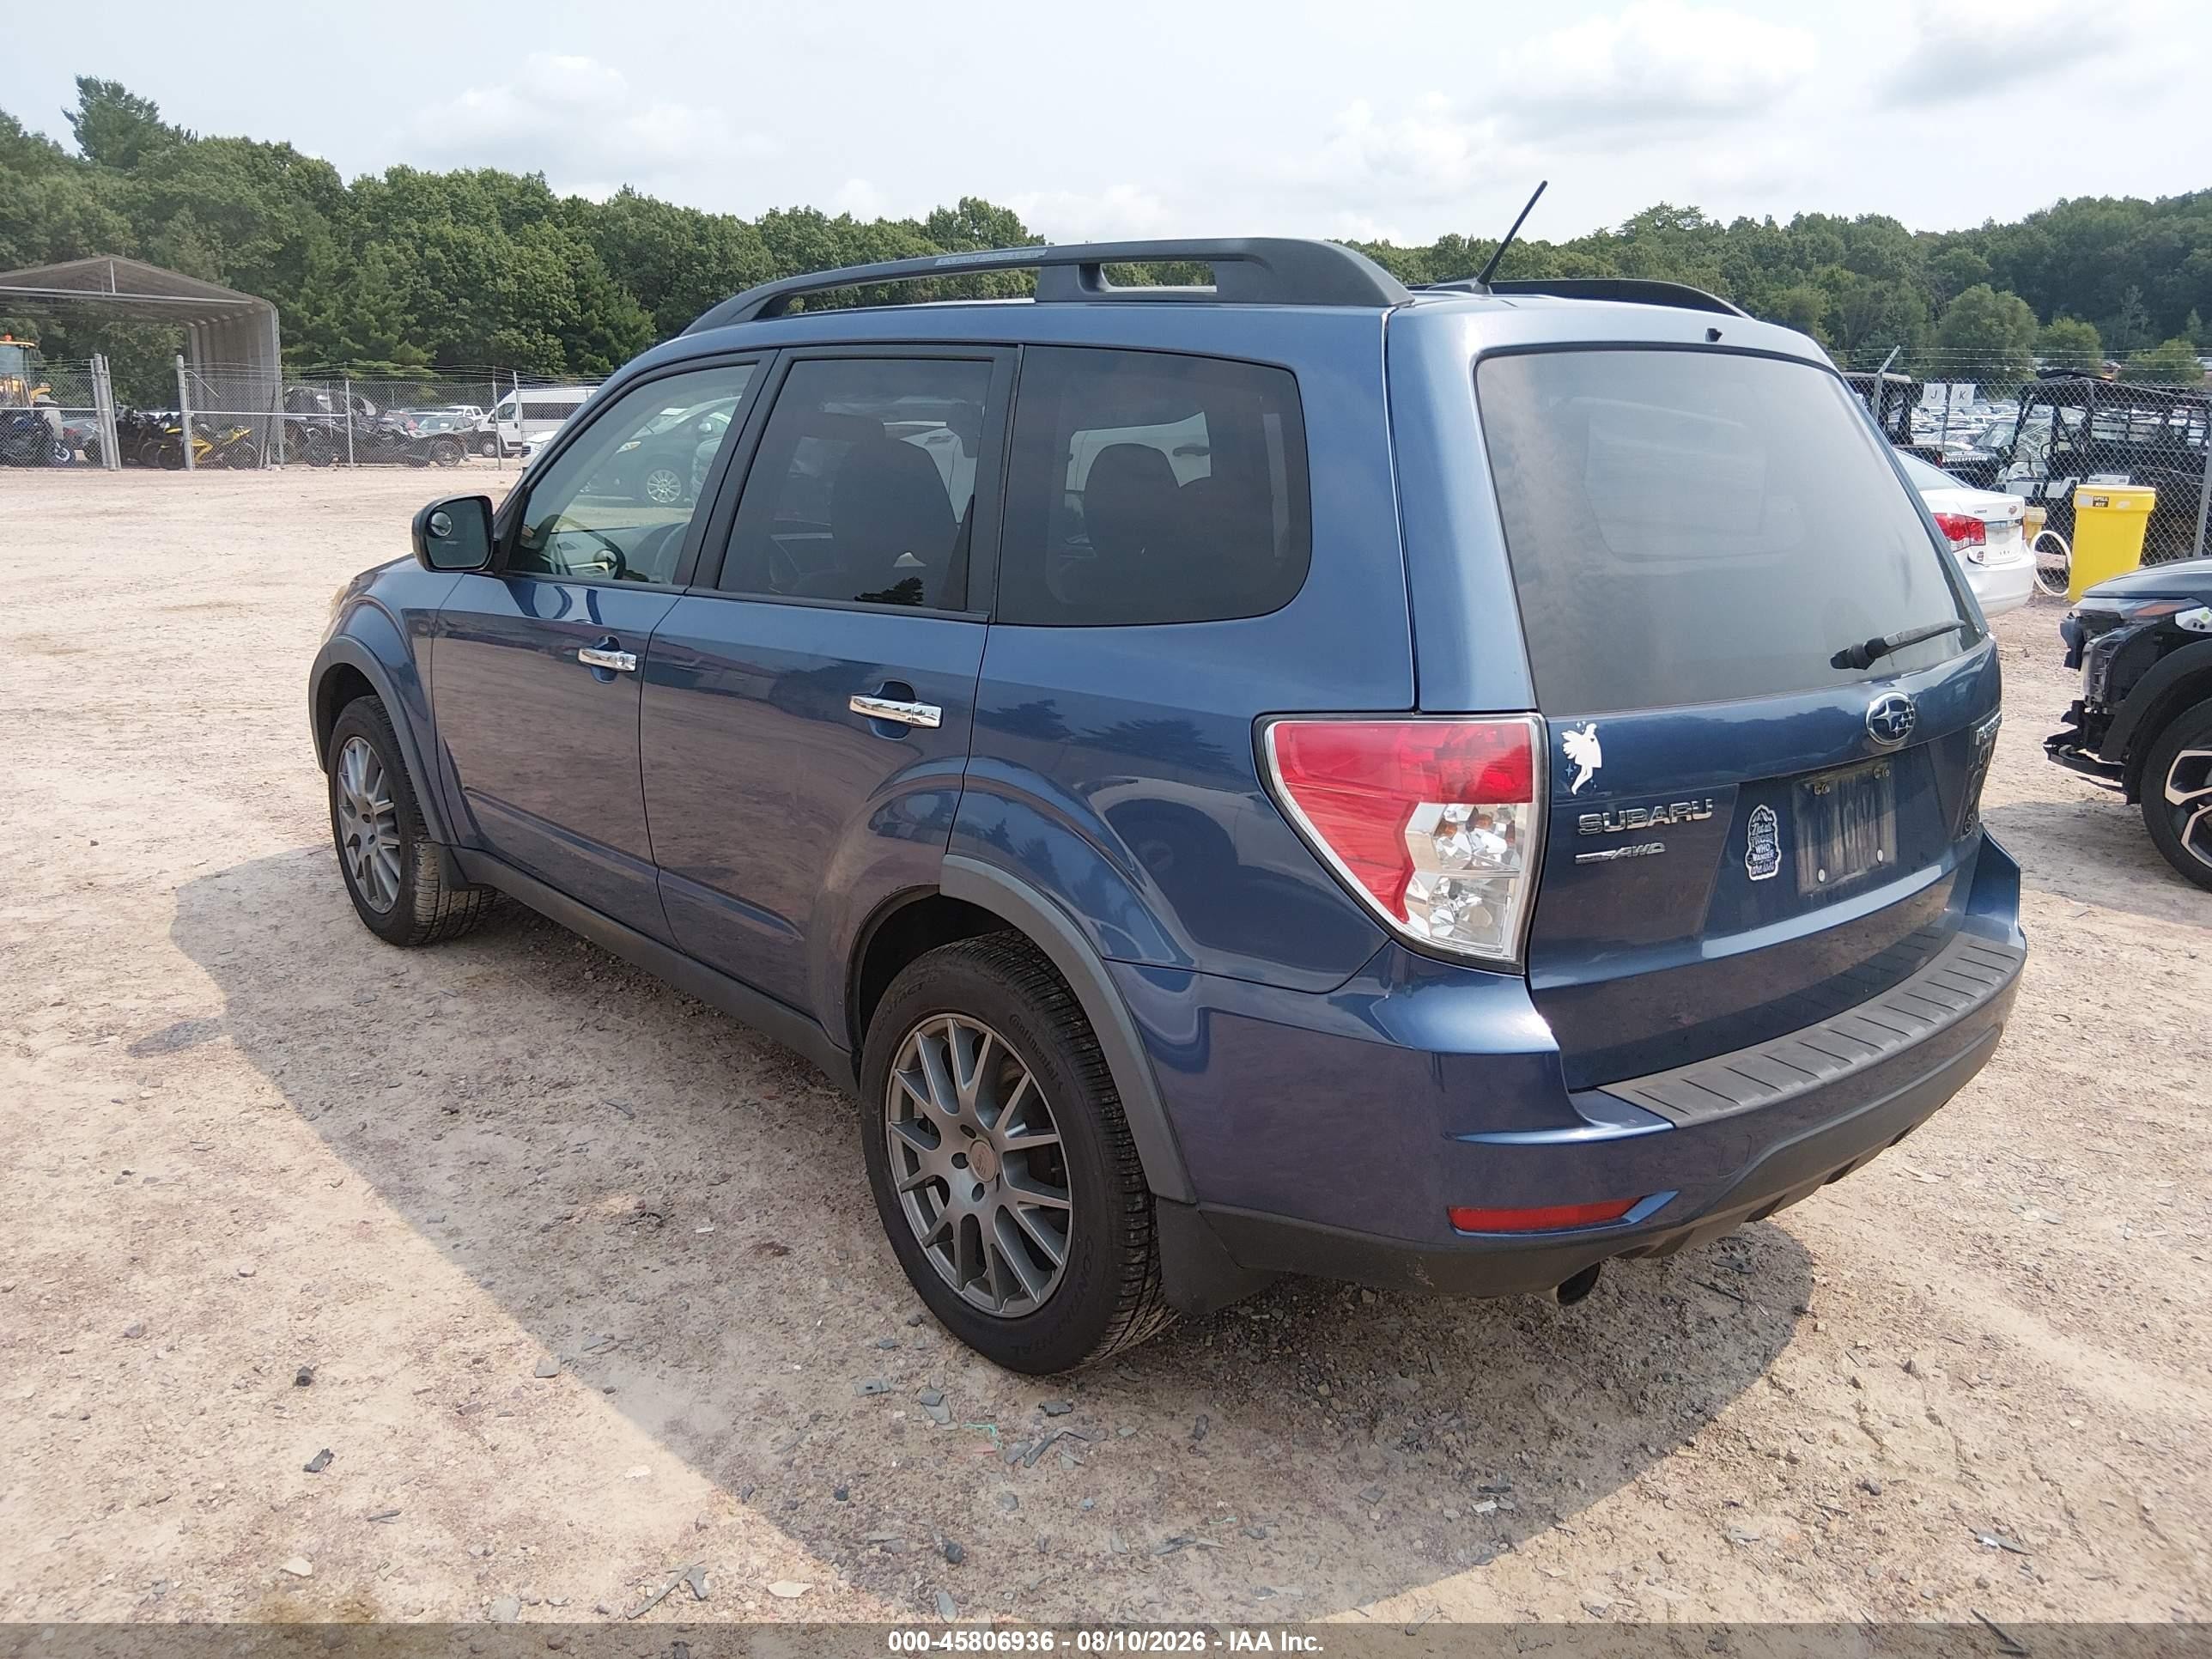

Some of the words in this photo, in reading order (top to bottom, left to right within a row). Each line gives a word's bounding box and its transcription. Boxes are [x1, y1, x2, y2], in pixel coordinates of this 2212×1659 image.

[1959, 390, 1966, 400] K
[1578, 799, 1714, 836] SUBARU
[1611, 842, 1666, 860] AWD
[1755, 843, 1771, 854] WHO
[1753, 849, 1775, 861] WANDER
